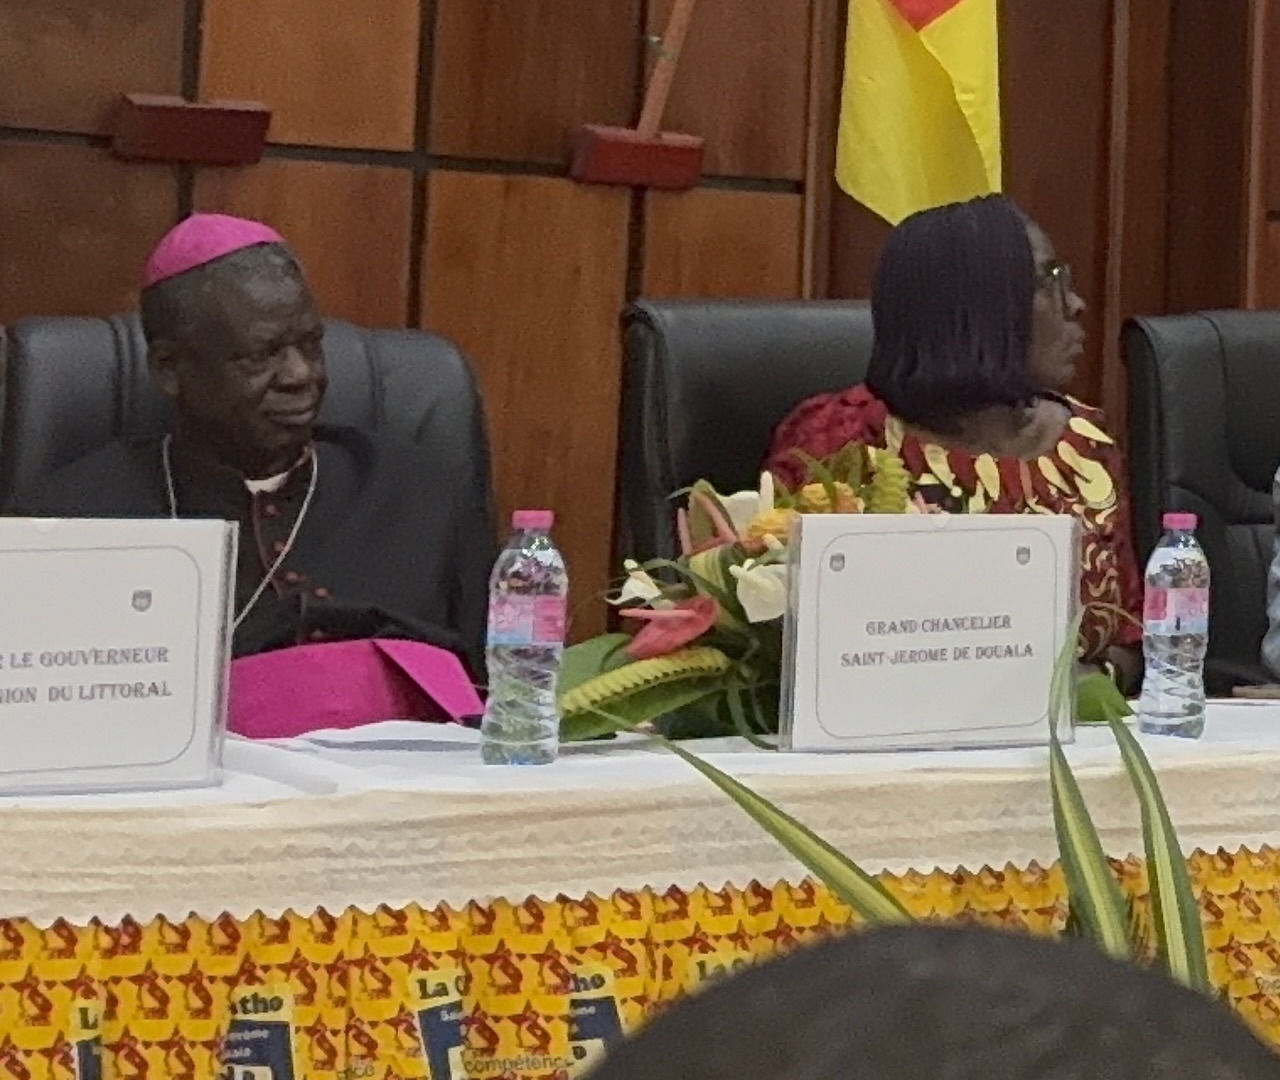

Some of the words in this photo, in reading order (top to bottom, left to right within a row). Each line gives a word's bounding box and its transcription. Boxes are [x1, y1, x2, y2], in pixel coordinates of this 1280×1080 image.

[866, 619, 918, 636] GRAND
[921, 615, 1012, 632] CHANCELIER
[10, 652, 33, 668] LE
[40, 646, 169, 668] GOUVERNEUR
[840, 648, 948, 667] SAINT-JEROME
[952, 646, 970, 661] DE
[975, 643, 1034, 659] DOUALA
[48, 685, 73, 702] DU
[78, 680, 172, 700] LITTORAL
[416, 978, 449, 1000] La
[463, 1050, 573, 1073] compétenc
